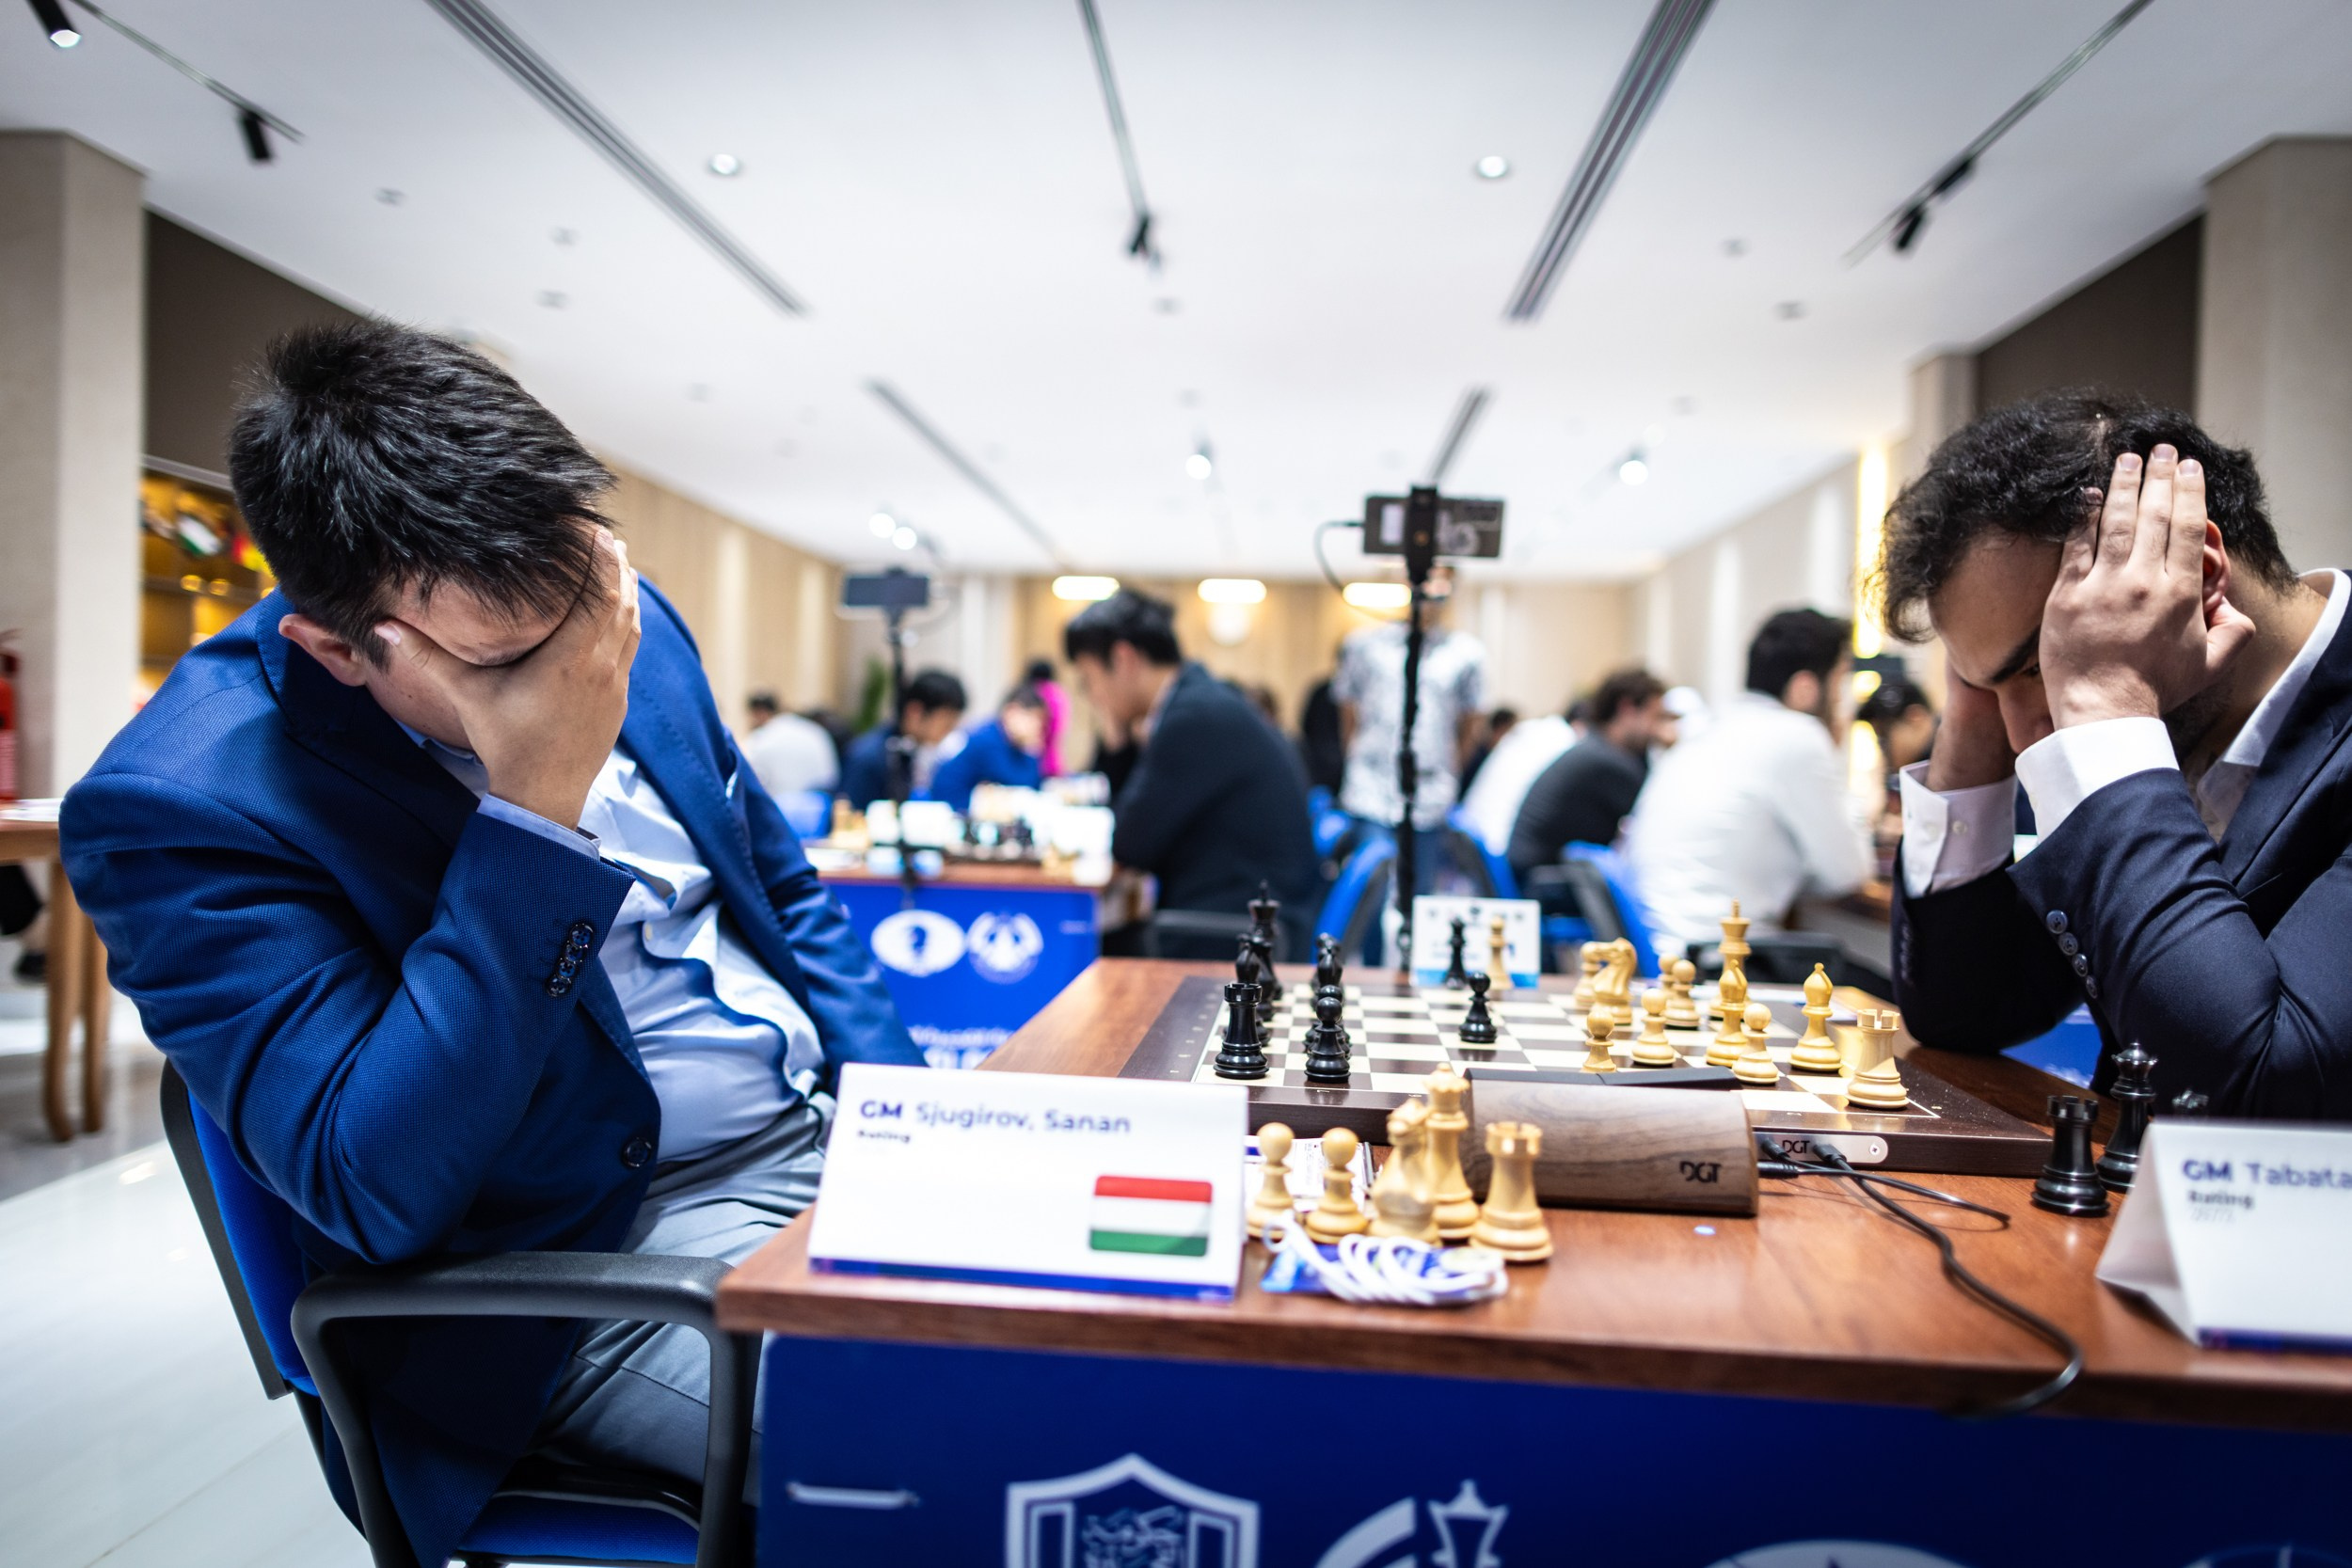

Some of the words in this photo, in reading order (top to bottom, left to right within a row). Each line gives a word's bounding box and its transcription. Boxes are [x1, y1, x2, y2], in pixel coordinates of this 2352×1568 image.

[916, 1101, 1034, 1131] Sjugirov,
[1044, 1108, 1131, 1134] Sanan
[1781, 1139, 1810, 1154] DGT
[1679, 1161, 1722, 1183] DGT
[2183, 1159, 2233, 1181] GM
